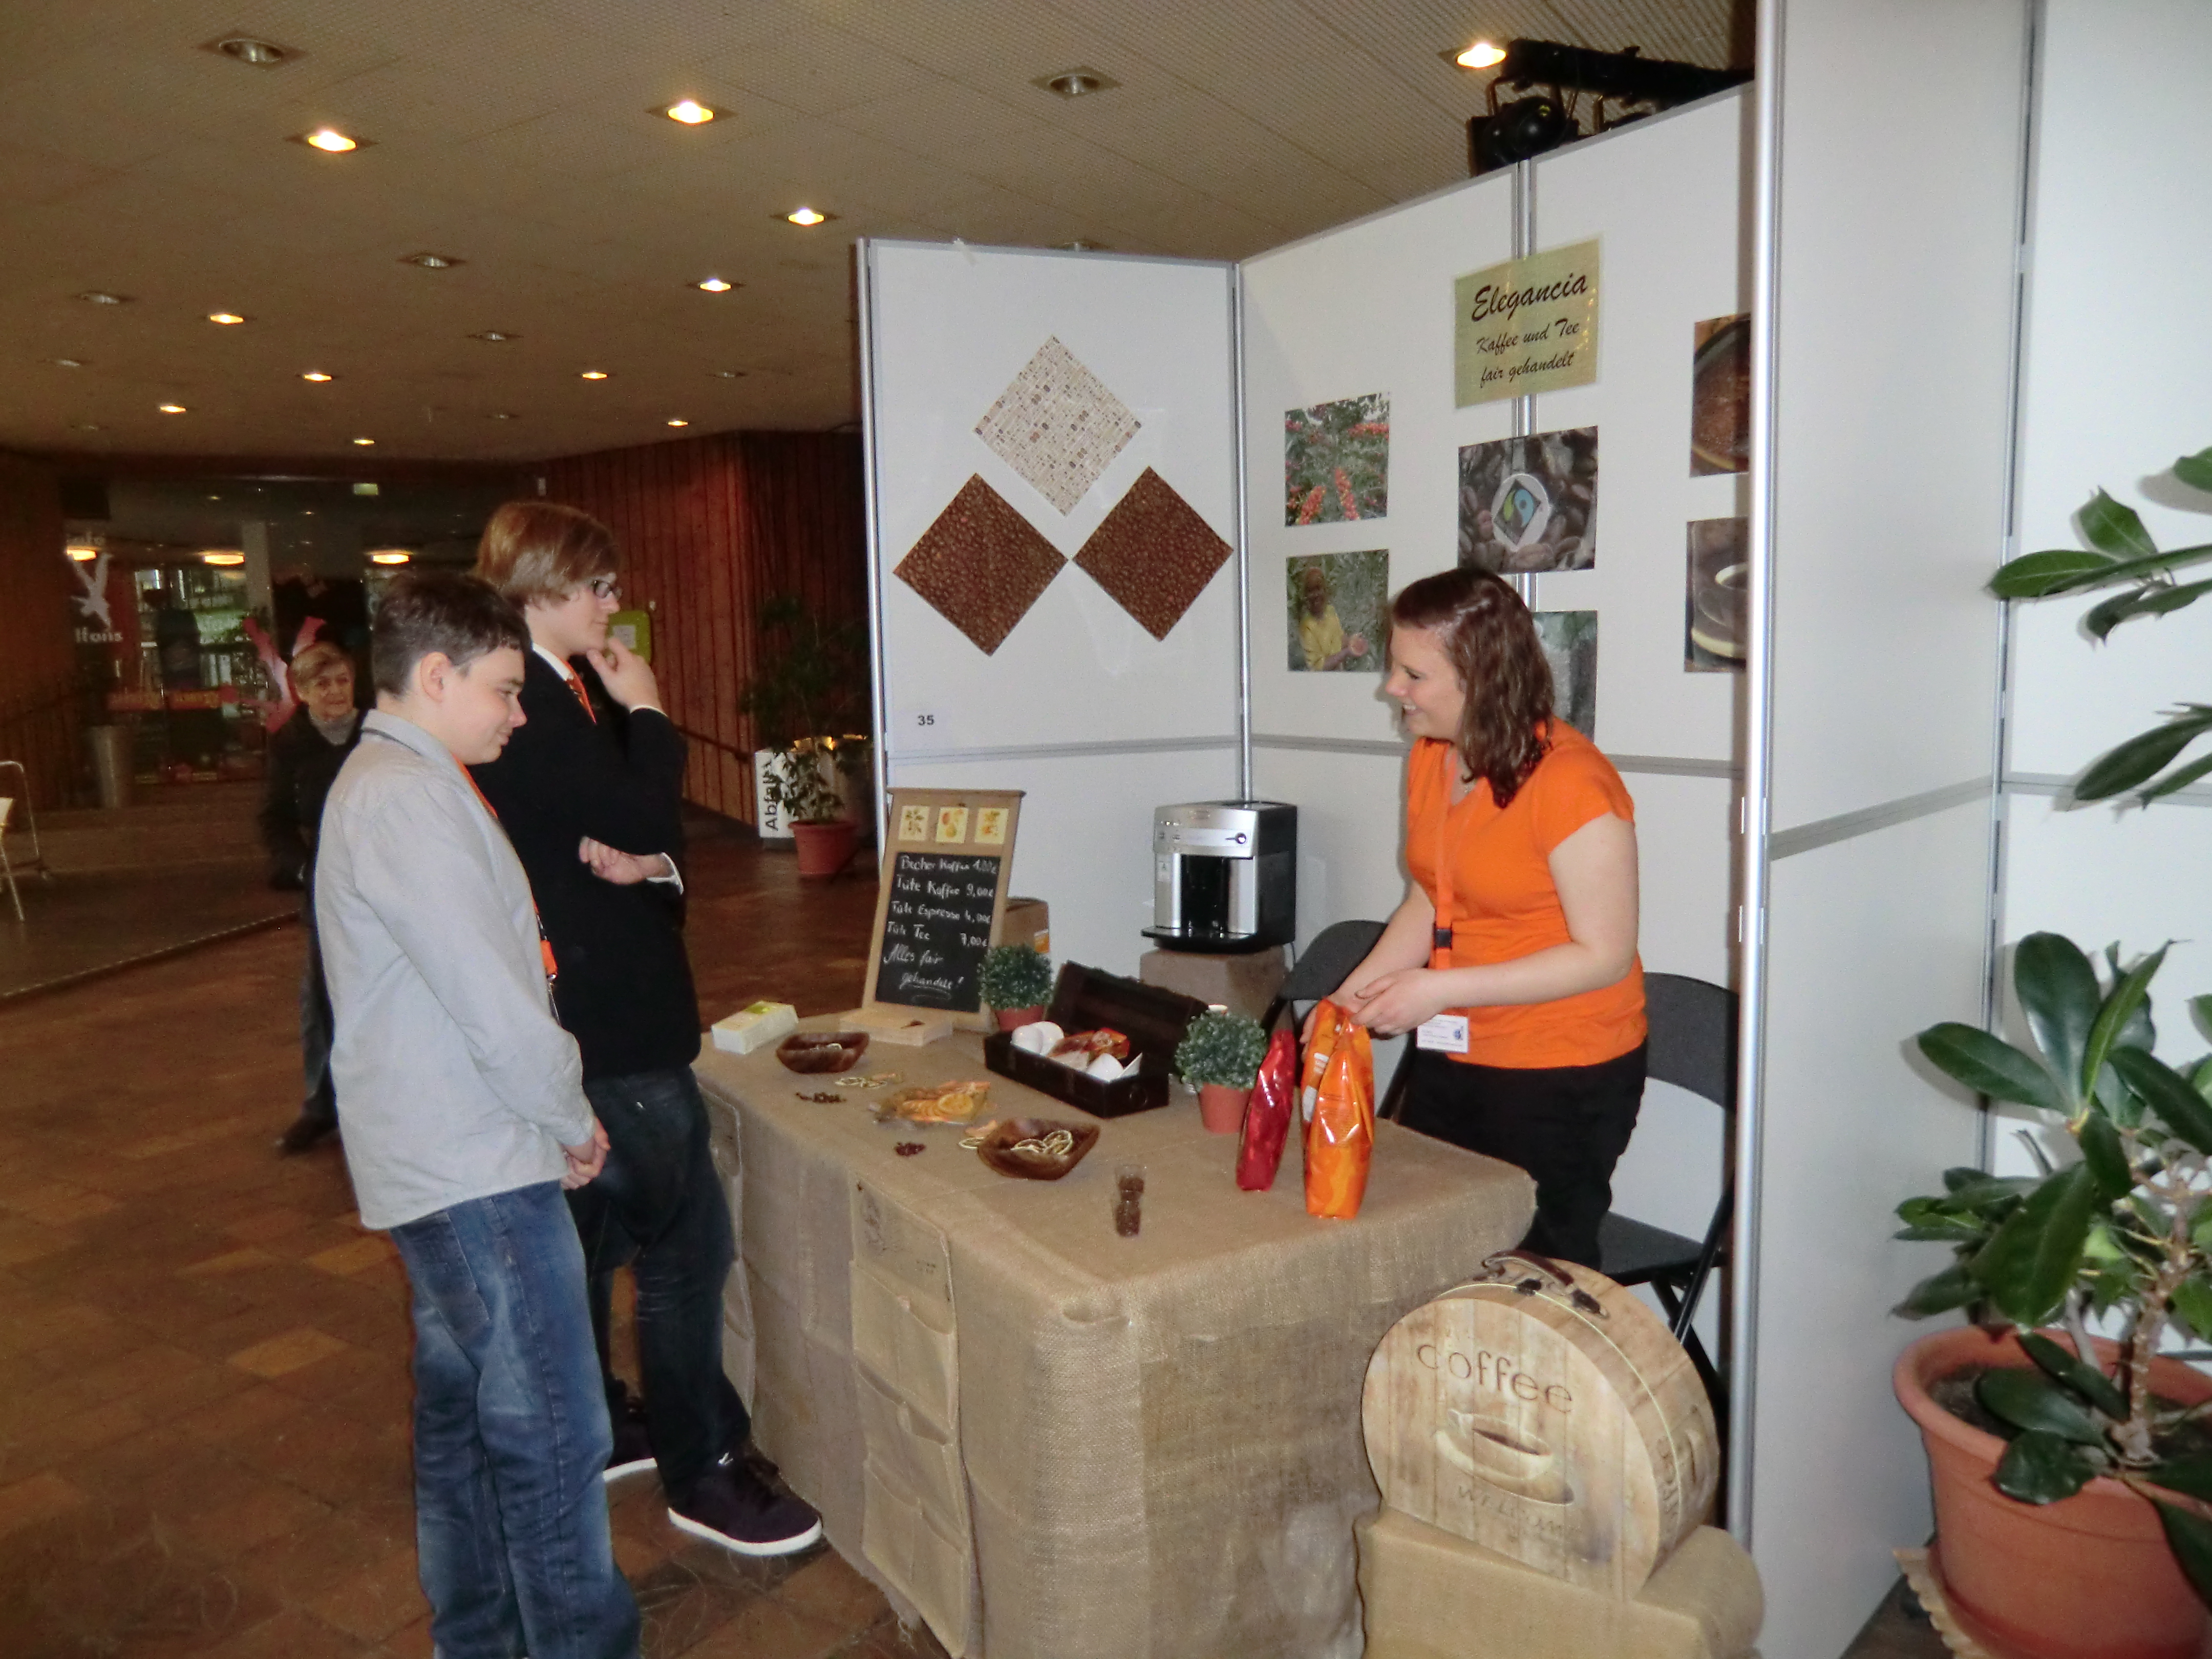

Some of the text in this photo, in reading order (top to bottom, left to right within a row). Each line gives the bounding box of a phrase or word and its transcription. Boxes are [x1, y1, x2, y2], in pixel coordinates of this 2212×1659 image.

[1471, 272, 1588, 322] Elegancia
[1476, 317, 1580, 355] Kaffee und Tee
[1479, 350, 1576, 388] fair gehandelt
[918, 715, 934, 726] 35
[927, 880, 960, 899] Kaffee
[913, 924, 930, 941] Tee
[920, 949, 944, 966] fair
